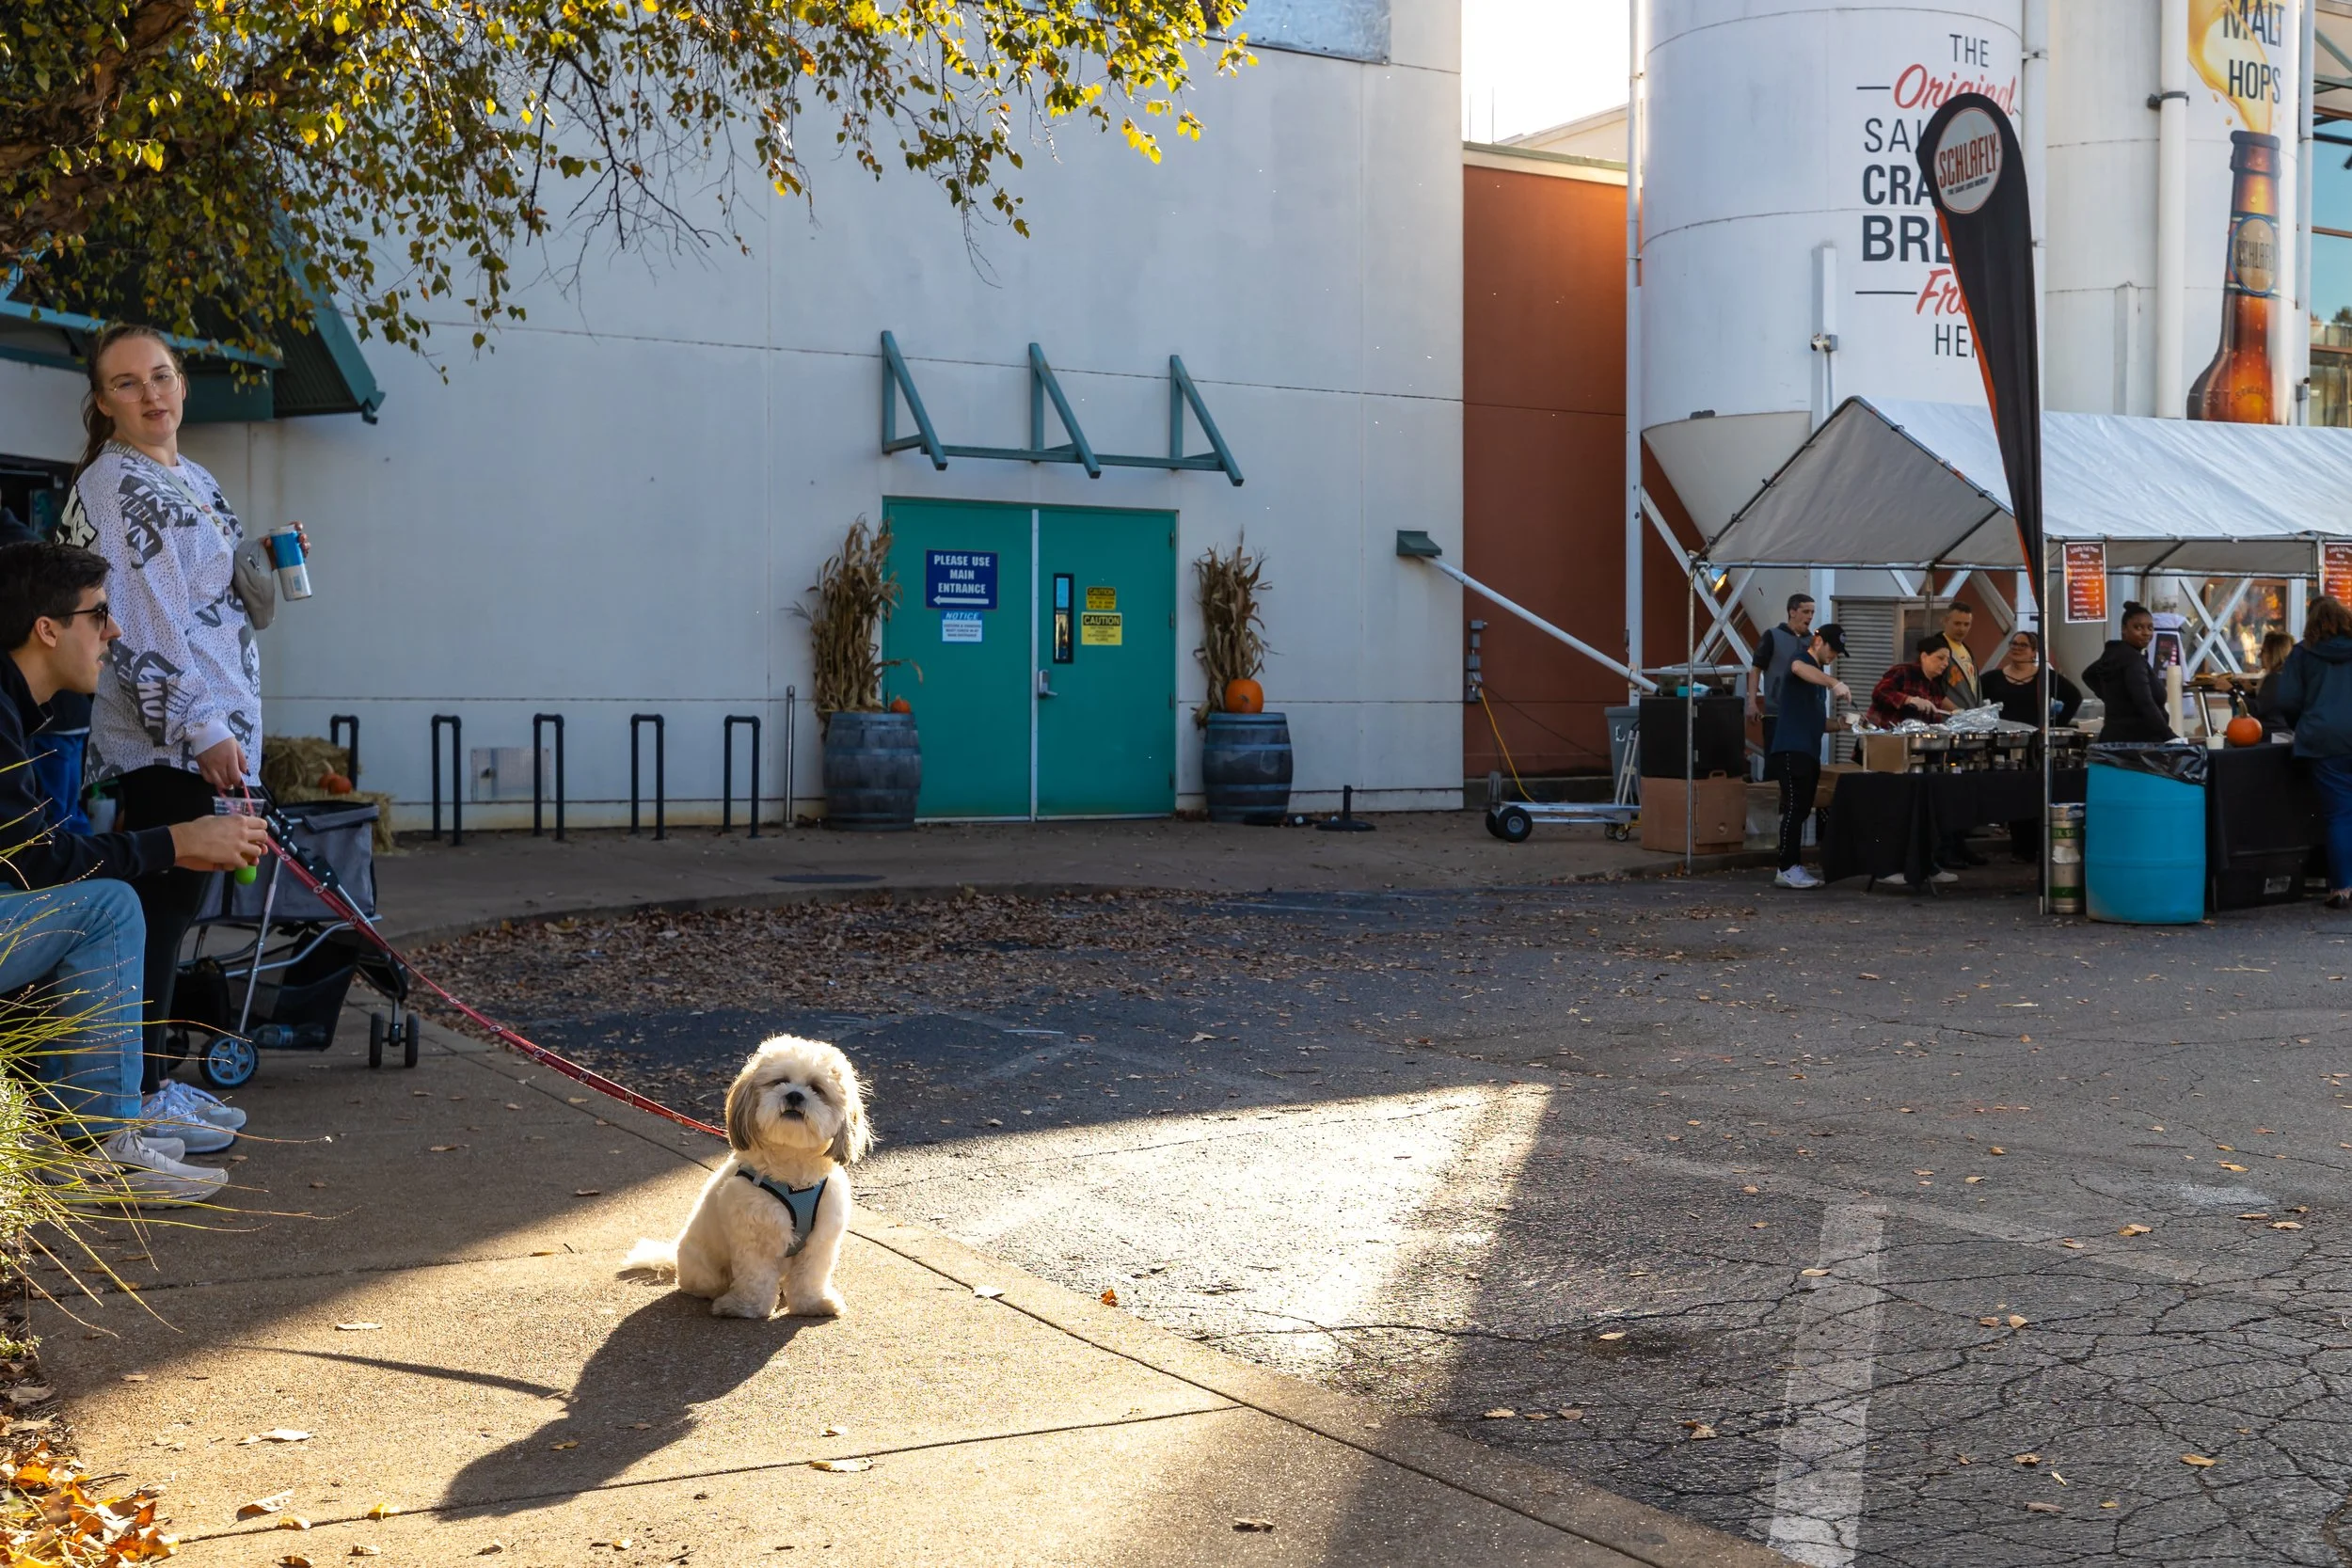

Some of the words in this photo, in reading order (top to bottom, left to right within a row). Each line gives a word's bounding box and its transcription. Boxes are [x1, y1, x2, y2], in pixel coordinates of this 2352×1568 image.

[2223, 0, 2285, 47] MALT
[1949, 34, 1989, 68] THE
[2229, 59, 2281, 104] HOPS
[1939, 133, 1996, 188] SCHLAFLY
[1863, 165, 1934, 206] CRA
[1863, 215, 1952, 263] BRE
[1915, 268, 1966, 316] Fr
[1935, 324, 1975, 357] HE
[934, 554, 968, 566] PLEASE
[972, 556, 991, 567] USE
[949, 569, 975, 580] MAIN
[938, 582, 986, 594] ENTRANCE
[1089, 587, 1114, 595] CAUTION
[945, 612, 979, 621] NOTICE
[1084, 615, 1120, 626] CAUTION
